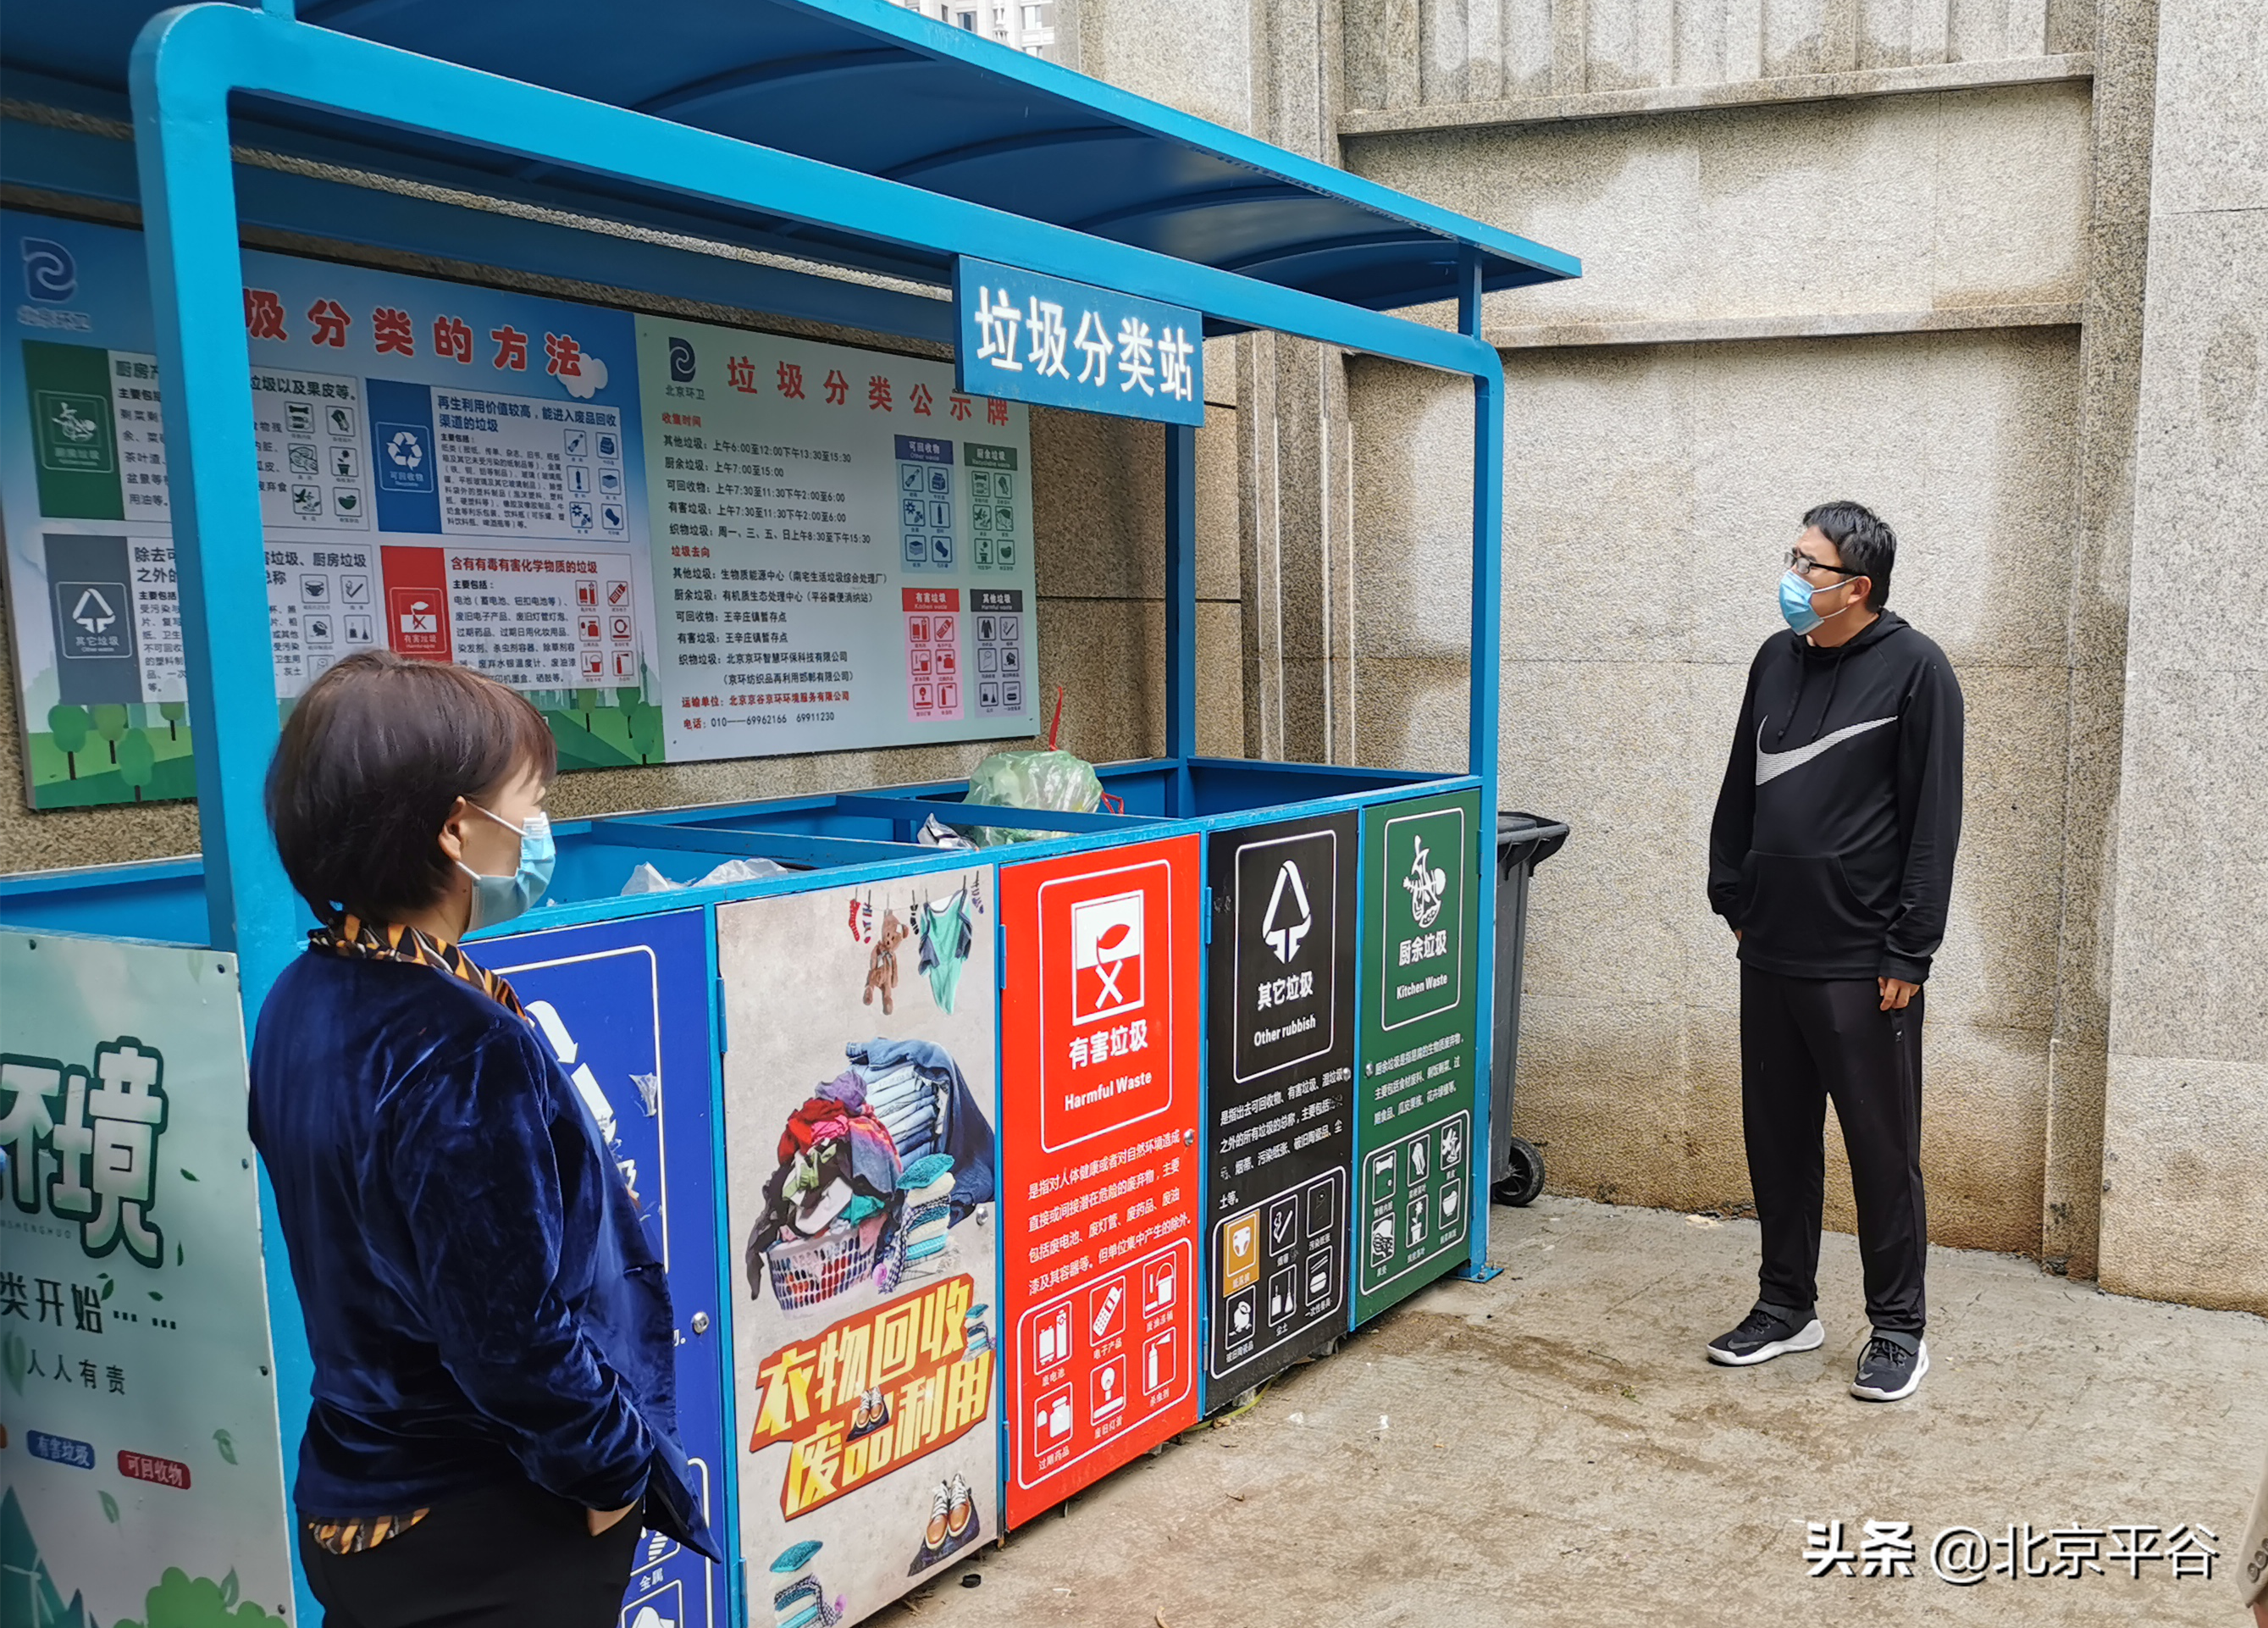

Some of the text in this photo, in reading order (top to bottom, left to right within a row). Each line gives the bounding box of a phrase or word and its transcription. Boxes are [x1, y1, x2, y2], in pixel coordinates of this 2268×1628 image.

[975, 285, 1194, 401] 垃圾分类站
[665, 385, 705, 401] 北京环卫
[727, 355, 1009, 426] 垃圾分类公示牌
[439, 414, 499, 433] 渠道的垃圾
[661, 413, 701, 428] 收集时间
[909, 440, 940, 454] 可回收物
[672, 545, 710, 558] 垃圾去向
[451, 557, 598, 574] 含有有毒有害化学物质的垃圾
[915, 592, 947, 604] 有害垃圾
[982, 593, 1011, 604] 其他垃圾
[796, 712, 834, 723] 69911230
[1398, 930, 1447, 967] 厨余垃圾
[1257, 970, 1314, 1011] 其它垃圾
[1397, 973, 1448, 1000] Kitchen Waste
[1253, 1014, 1316, 1047] Other rubbish
[1069, 1019, 1148, 1070] 有害垃圾
[1065, 1071, 1152, 1111] Harmful Waste
[1027, 1128, 1181, 1201] 是指对人体健康或者对自然环境造成
[1028, 1157, 1181, 1232] 直接或间接潜在危险的废弃物，主要
[755, 1277, 971, 1437] 衣物回收
[1093, 1337, 1123, 1359] 电子产品
[27, 1348, 125, 1395] 人人有责
[785, 1350, 991, 1517] 废品利用
[1038, 1445, 1070, 1471] 过期药品
[639, 1567, 664, 1592] 金属
